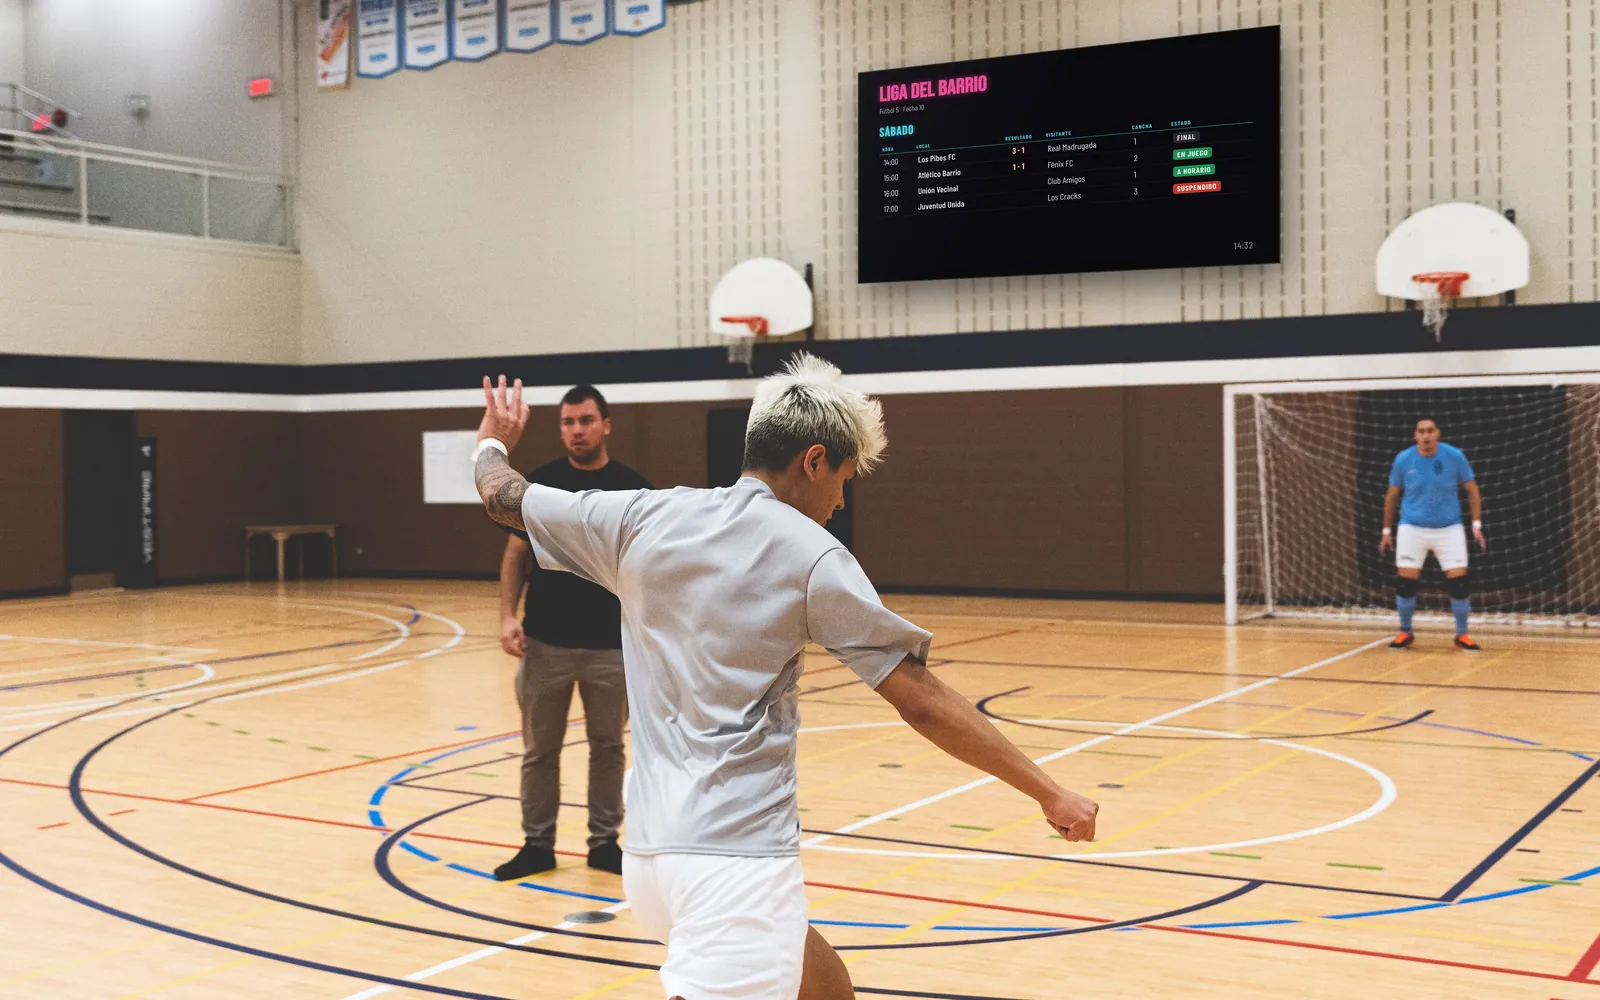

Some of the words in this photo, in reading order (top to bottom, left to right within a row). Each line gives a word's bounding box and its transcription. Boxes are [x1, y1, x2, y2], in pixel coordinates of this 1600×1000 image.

[879, 83, 908, 102] LIGA
[911, 81, 935, 99] DEL
[938, 75, 988, 96] BARRIO
[902, 105, 918, 113] Fecha
[879, 124, 914, 138] SÁBADO
[883, 158, 899, 166] 14:00
[917, 156, 929, 164] Los
[929, 154, 947, 162] Pibes
[947, 153, 956, 161] FC
[1047, 144, 1061, 152] Real
[1062, 142, 1097, 151] Madrugada
[1133, 137, 1137, 145] 1
[1176, 133, 1196, 141] FINAL
[883, 174, 899, 182] 15:00
[917, 170, 941, 179] Atlético
[942, 169, 962, 177] Barrio
[1047, 161, 1065, 169] Fénix
[1065, 159, 1074, 167] FC
[1133, 154, 1139, 162] 2
[1187, 149, 1209, 157] JUEGO
[883, 189, 899, 197] 16:00
[917, 187, 936, 195] Unión
[936, 185, 959, 193] Vecinal
[1047, 177, 1062, 185] Club
[1062, 176, 1086, 185] Amigos
[1133, 171, 1137, 179] 1
[1183, 166, 1212, 174] HORARIO
[883, 205, 899, 213] 17:00
[917, 201, 947, 211] Juventud
[947, 200, 965, 208] Unida
[1047, 194, 1059, 202] Los
[1059, 192, 1082, 201] Cracks
[1133, 187, 1139, 195] 3
[1176, 183, 1217, 192] SUSPENDIDO
[1232, 241, 1254, 250] 14:32
